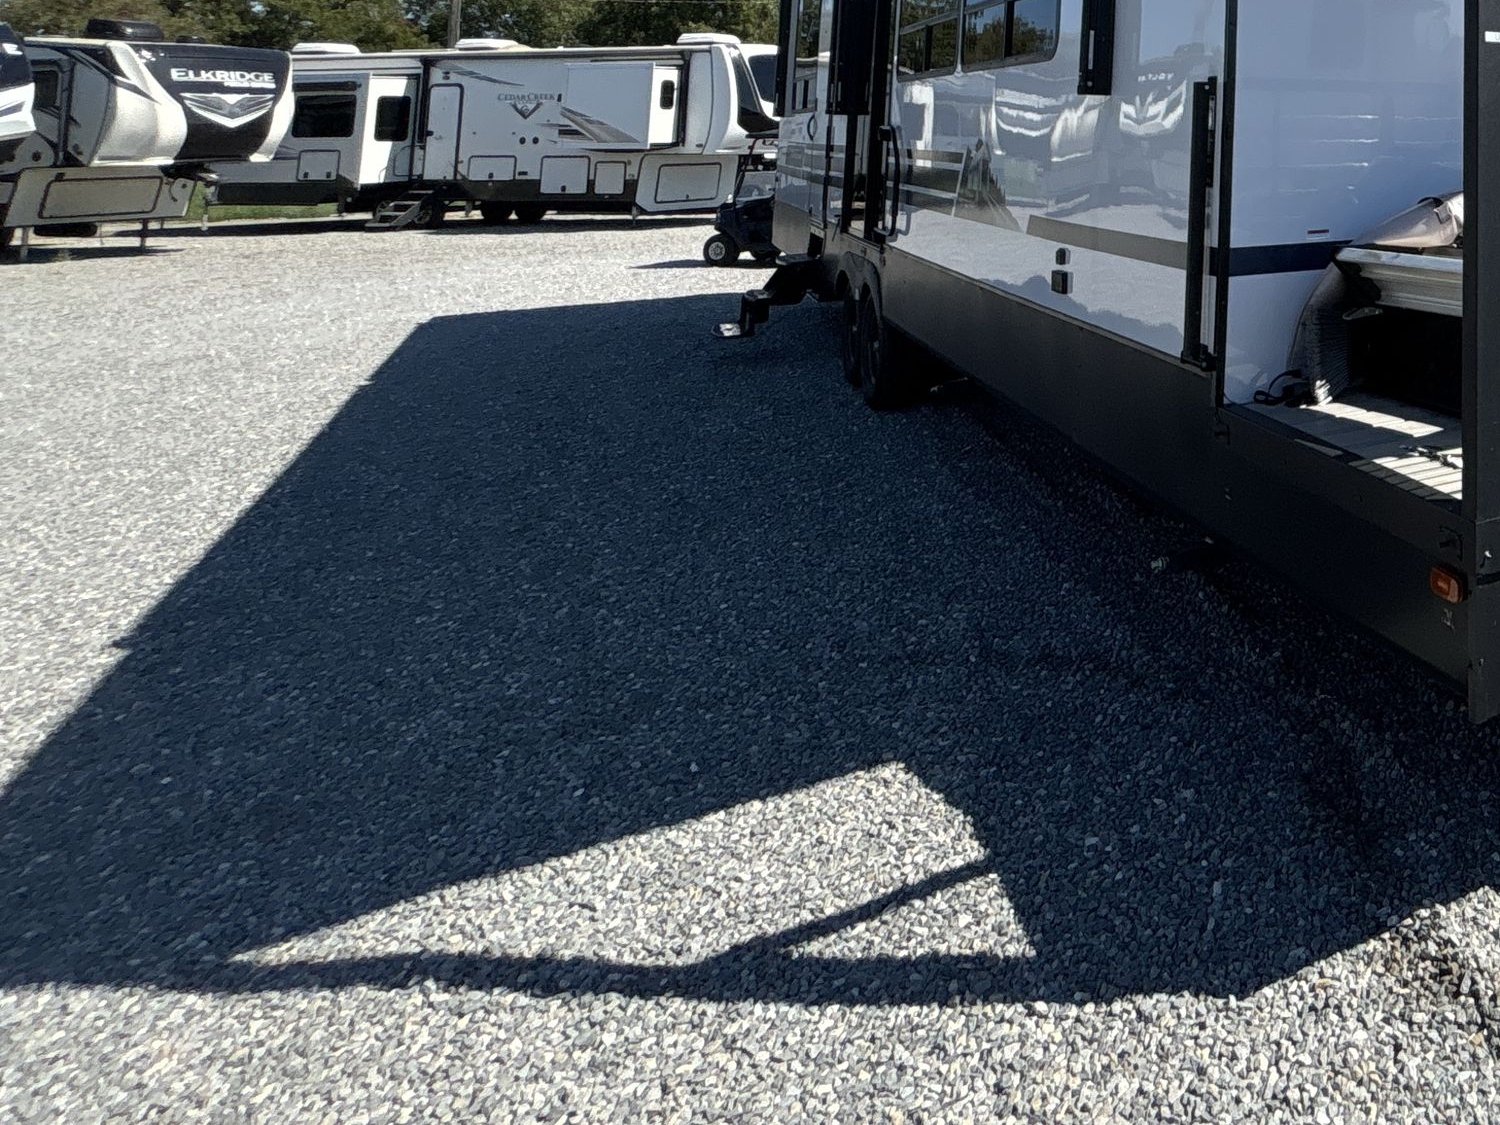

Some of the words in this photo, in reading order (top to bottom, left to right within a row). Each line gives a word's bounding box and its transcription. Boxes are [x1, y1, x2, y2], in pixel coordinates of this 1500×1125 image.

[170, 68, 276, 82] ELKRIDGE
[498, 93, 526, 101] CEDAR
[527, 92, 555, 101] CREEK
